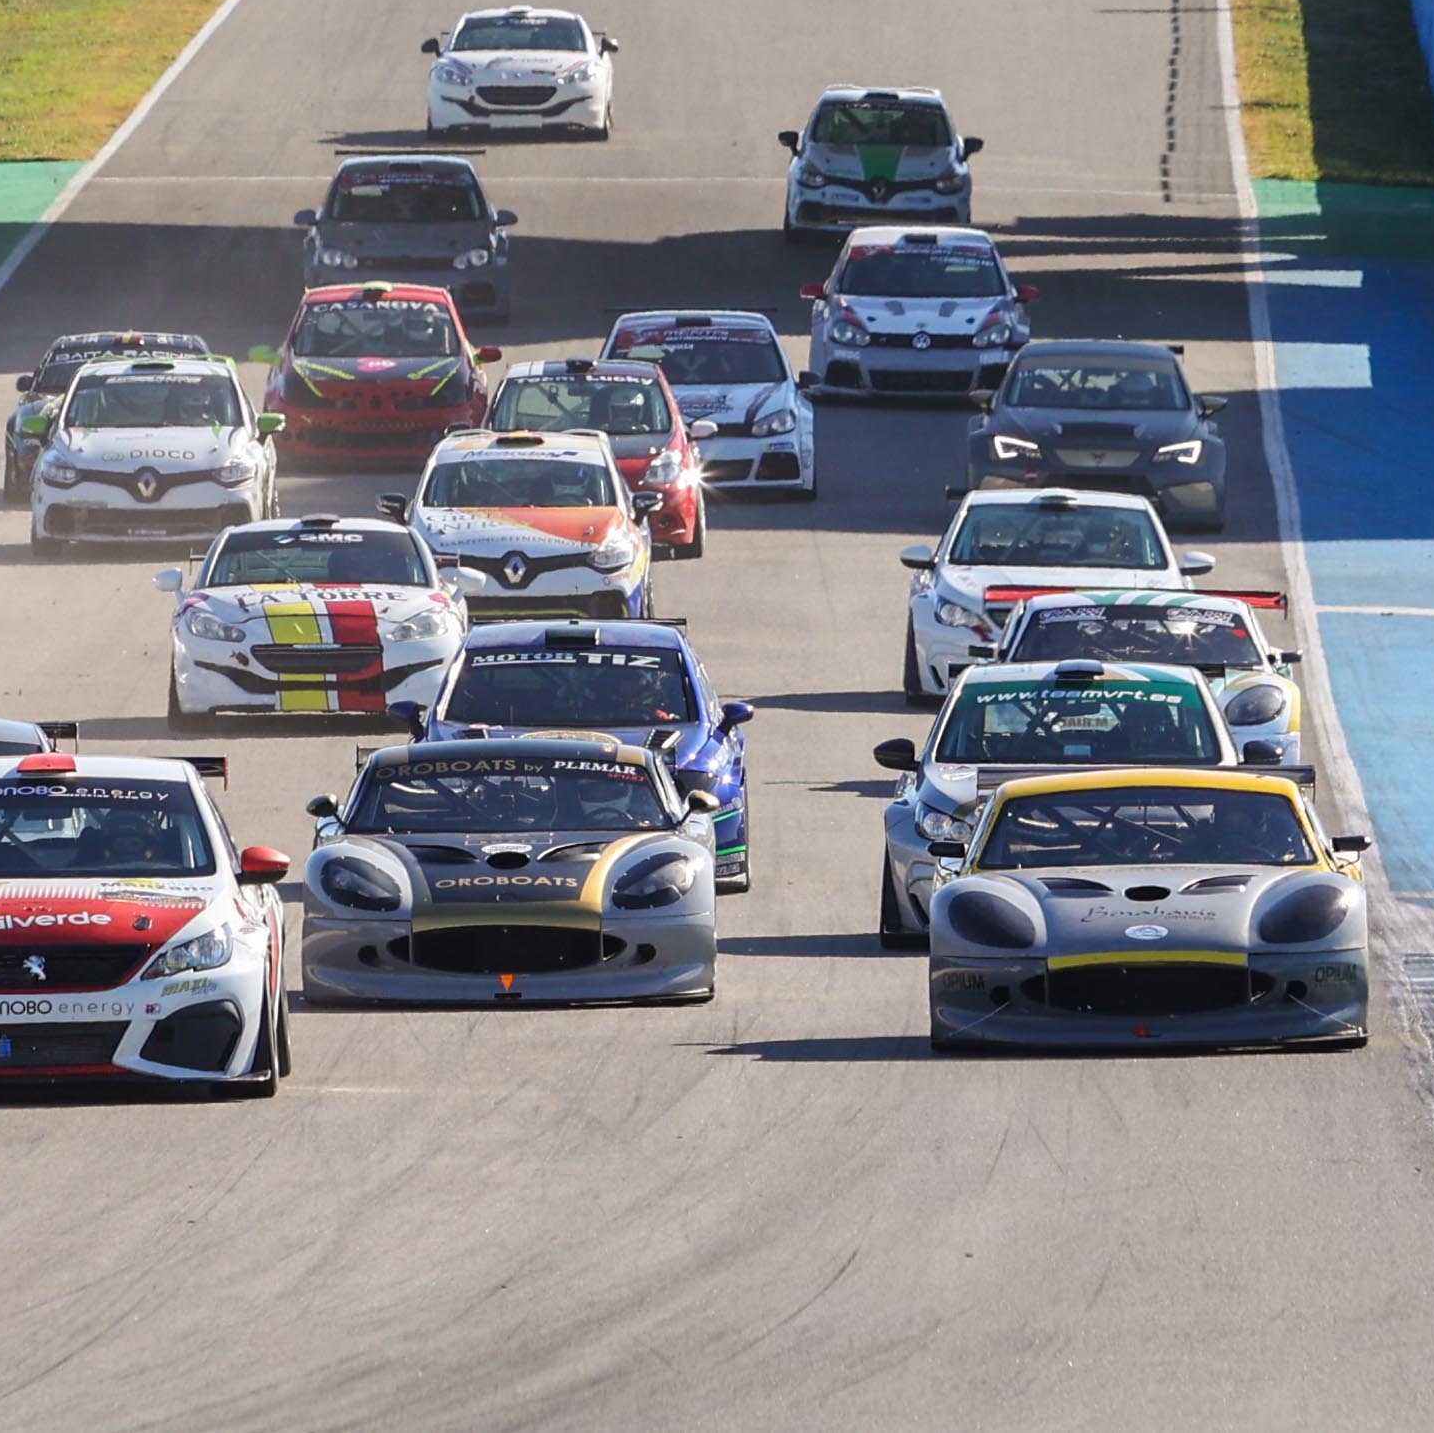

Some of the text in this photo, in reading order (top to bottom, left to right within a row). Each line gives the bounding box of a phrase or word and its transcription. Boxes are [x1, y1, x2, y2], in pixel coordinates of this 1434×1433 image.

[312, 300, 440, 313] CASANOVA
[299, 590, 409, 603] TORRE
[473, 652, 662, 668] MOTOR TIZ
[375, 759, 637, 780] OROBOATS by PLEMAR
[434, 875, 579, 889] OROBOATS
[1314, 964, 1358, 983] OPIUM
[58, 1001, 136, 1017] energy
